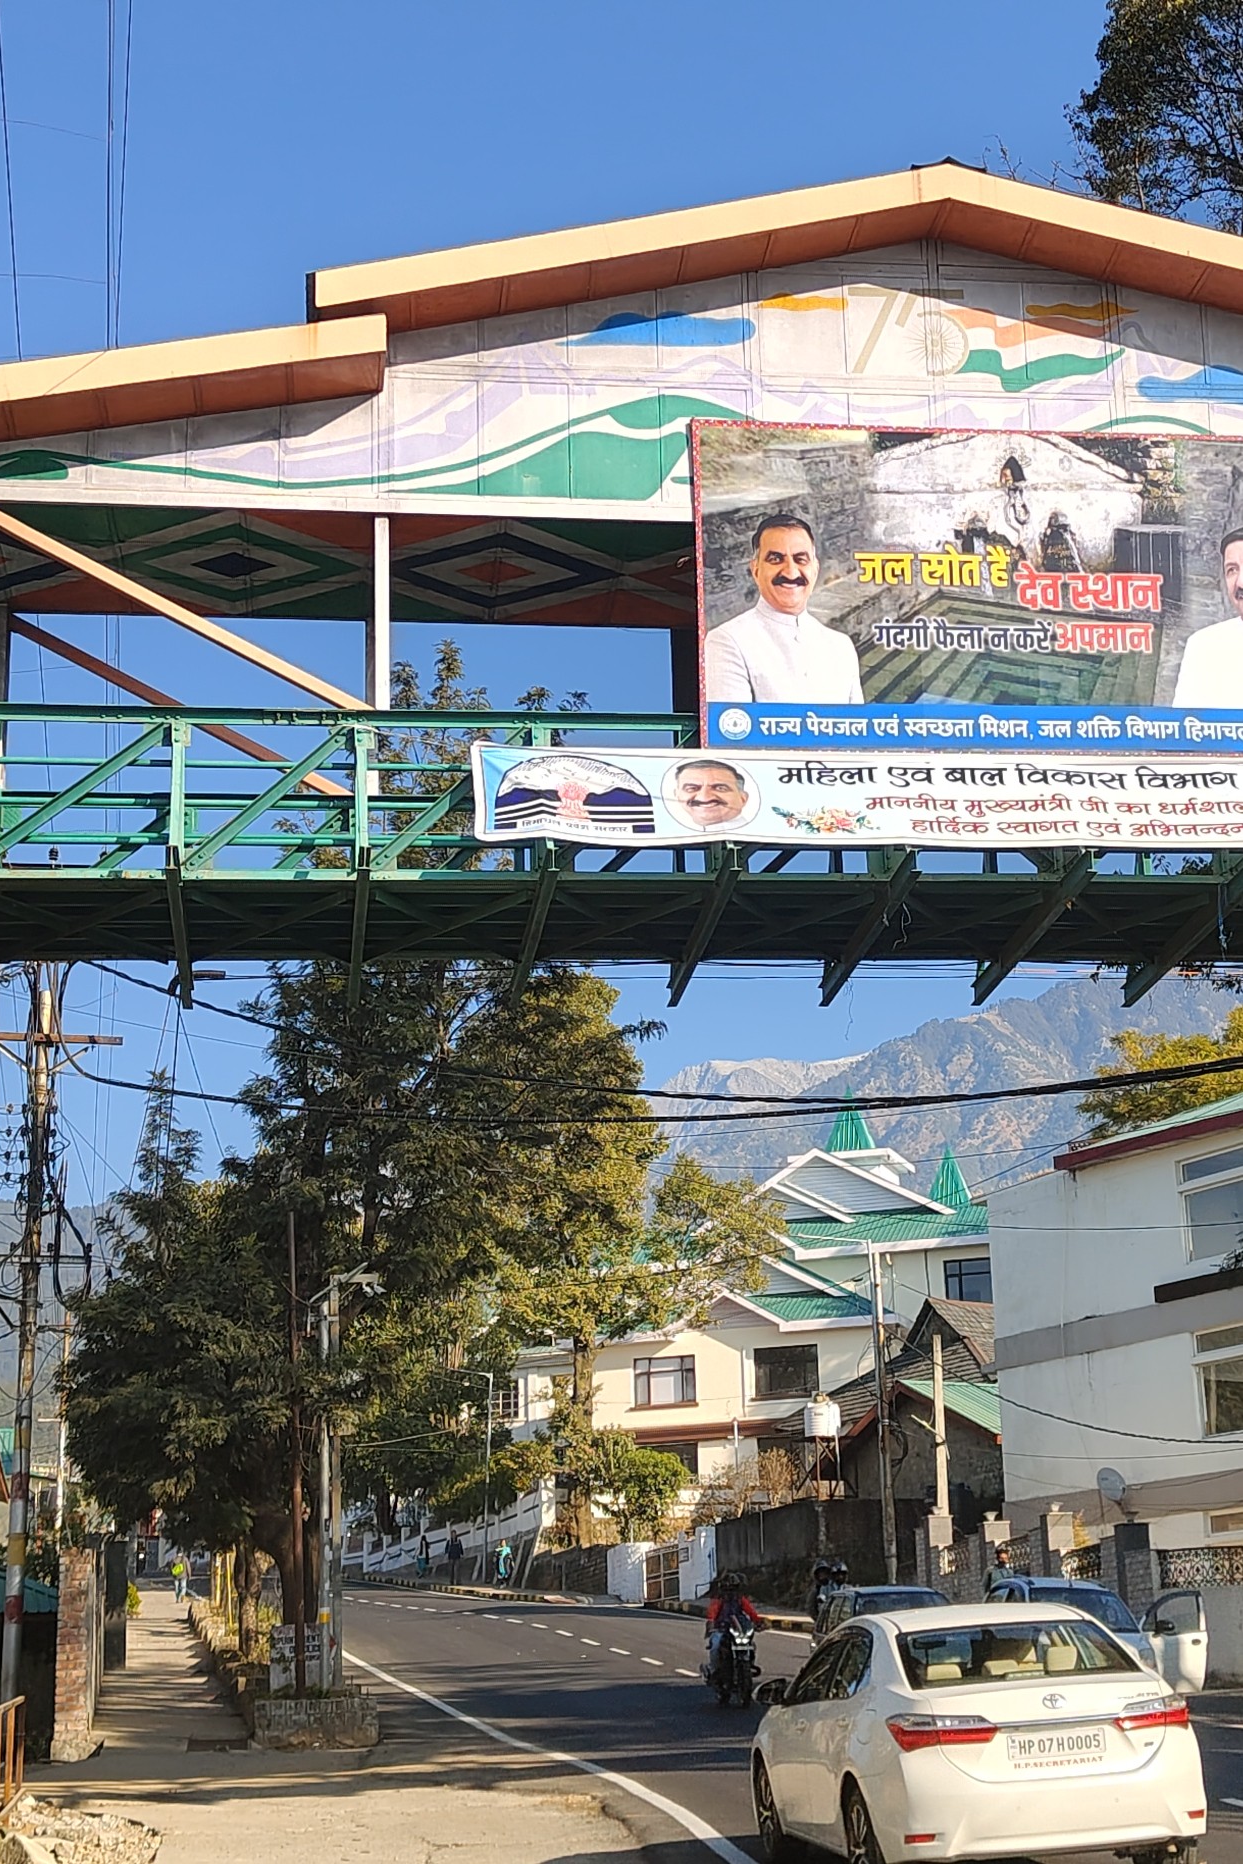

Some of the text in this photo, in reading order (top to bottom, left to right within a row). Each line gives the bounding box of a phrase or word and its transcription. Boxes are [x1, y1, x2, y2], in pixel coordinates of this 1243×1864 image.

[854, 544, 1010, 589] जल स्रोत हैं
[1014, 560, 1163, 612] देव स्थान
[874, 618, 1154, 653] गंदगी फैला न करें अपमान
[759, 717, 802, 737] राज्य
[806, 711, 868, 737] पेयजल
[872, 713, 899, 737] एवं
[904, 717, 974, 738] स्वच्छता
[978, 714, 1033, 741] मिशन,
[1037, 719, 1071, 738] जल
[1076, 715, 1121, 739] शक्ति
[1125, 715, 1180, 739] विभाग
[777, 760, 1238, 790] महिला एवं बाल विकास विभाग
[865, 793, 958, 811] माननीय
[963, 793, 1072, 817] मुख्यमंत्री
[1078, 796, 1109, 814] जी
[1114, 802, 1151, 815] का
[910, 816, 990, 835] हार्दिक
[997, 820, 1079, 835] स्वागत
[1086, 818, 1122, 837] एवं
